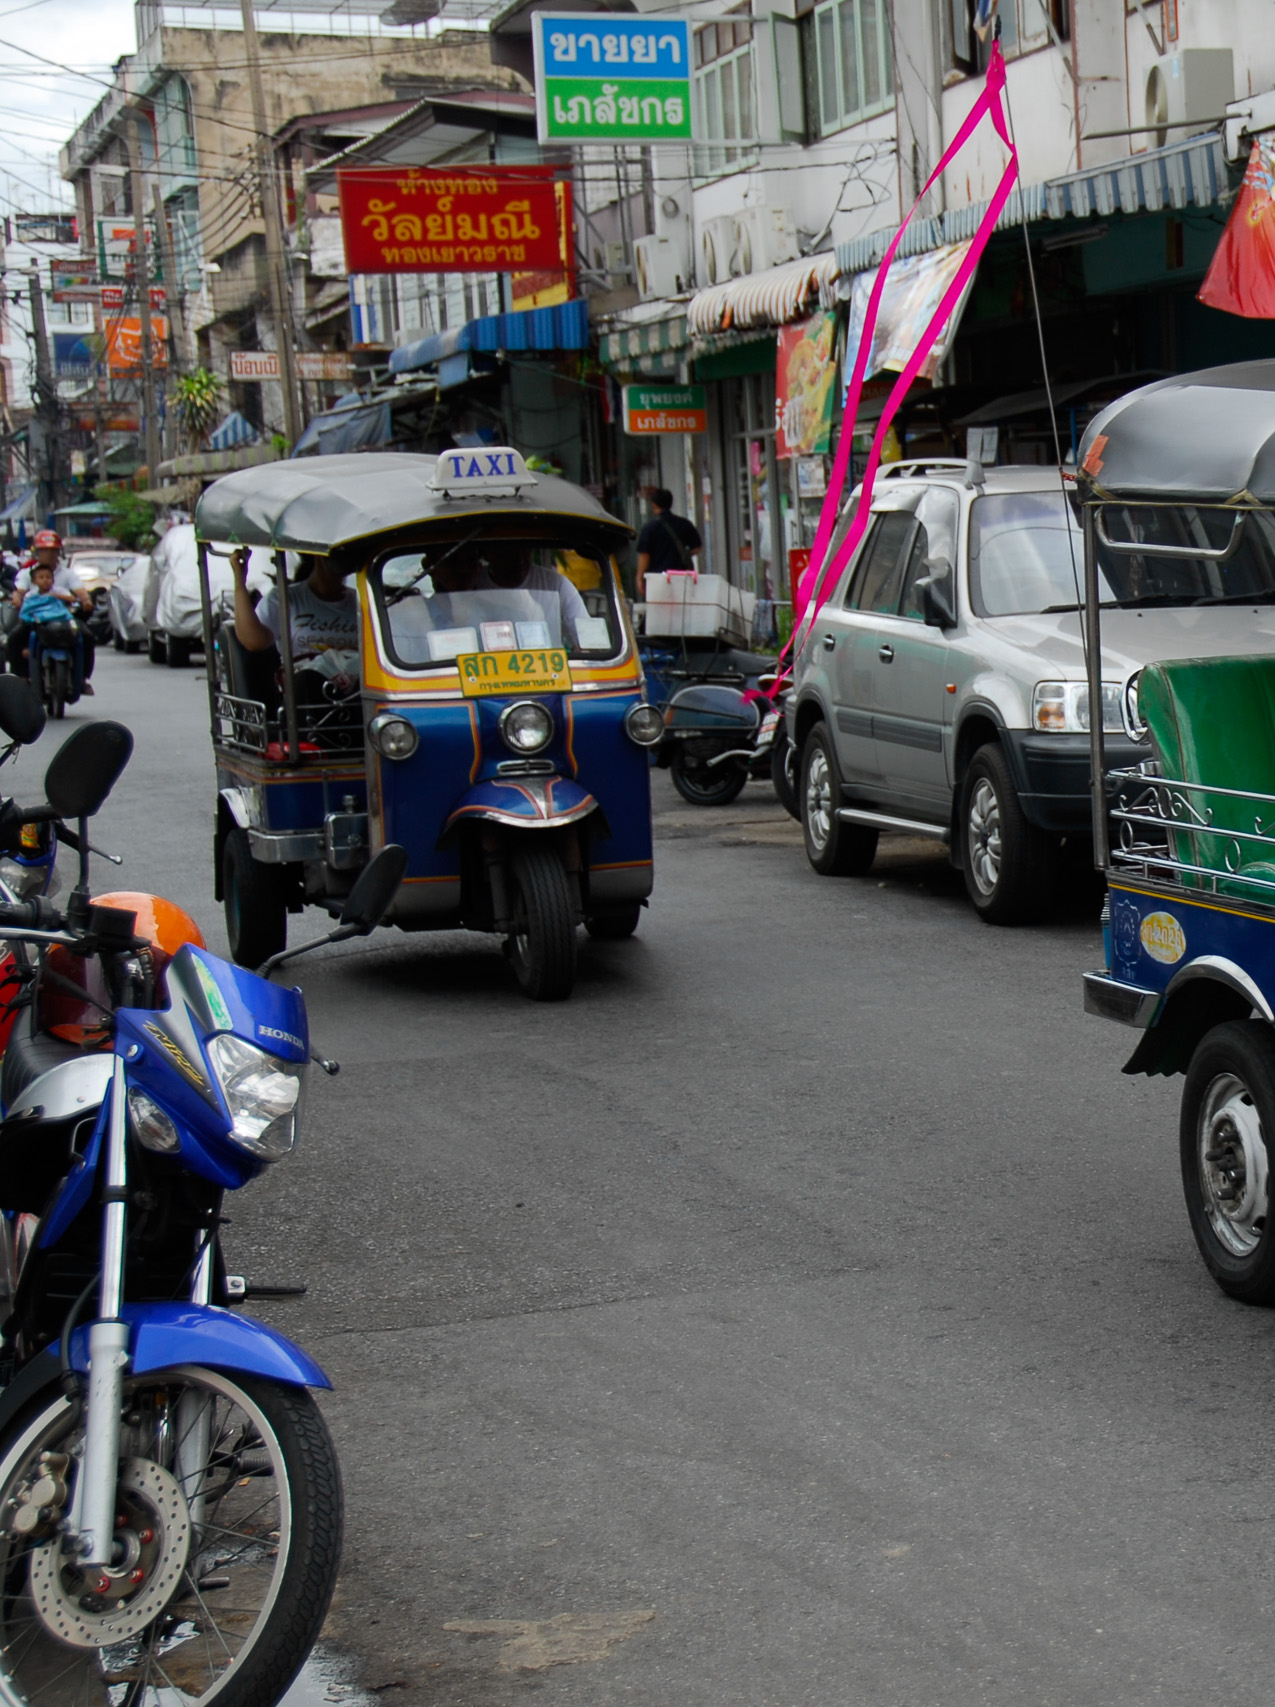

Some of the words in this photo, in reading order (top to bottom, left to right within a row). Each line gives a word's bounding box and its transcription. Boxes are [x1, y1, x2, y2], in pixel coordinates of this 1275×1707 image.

[550, 32, 681, 64] ขายยา
[553, 83, 684, 125] เภสัชกร
[361, 196, 541, 241] วัลย์มณี
[447, 453, 517, 478] TAXI
[507, 652, 565, 674] 4219
[258, 1025, 305, 1050] HONDA
